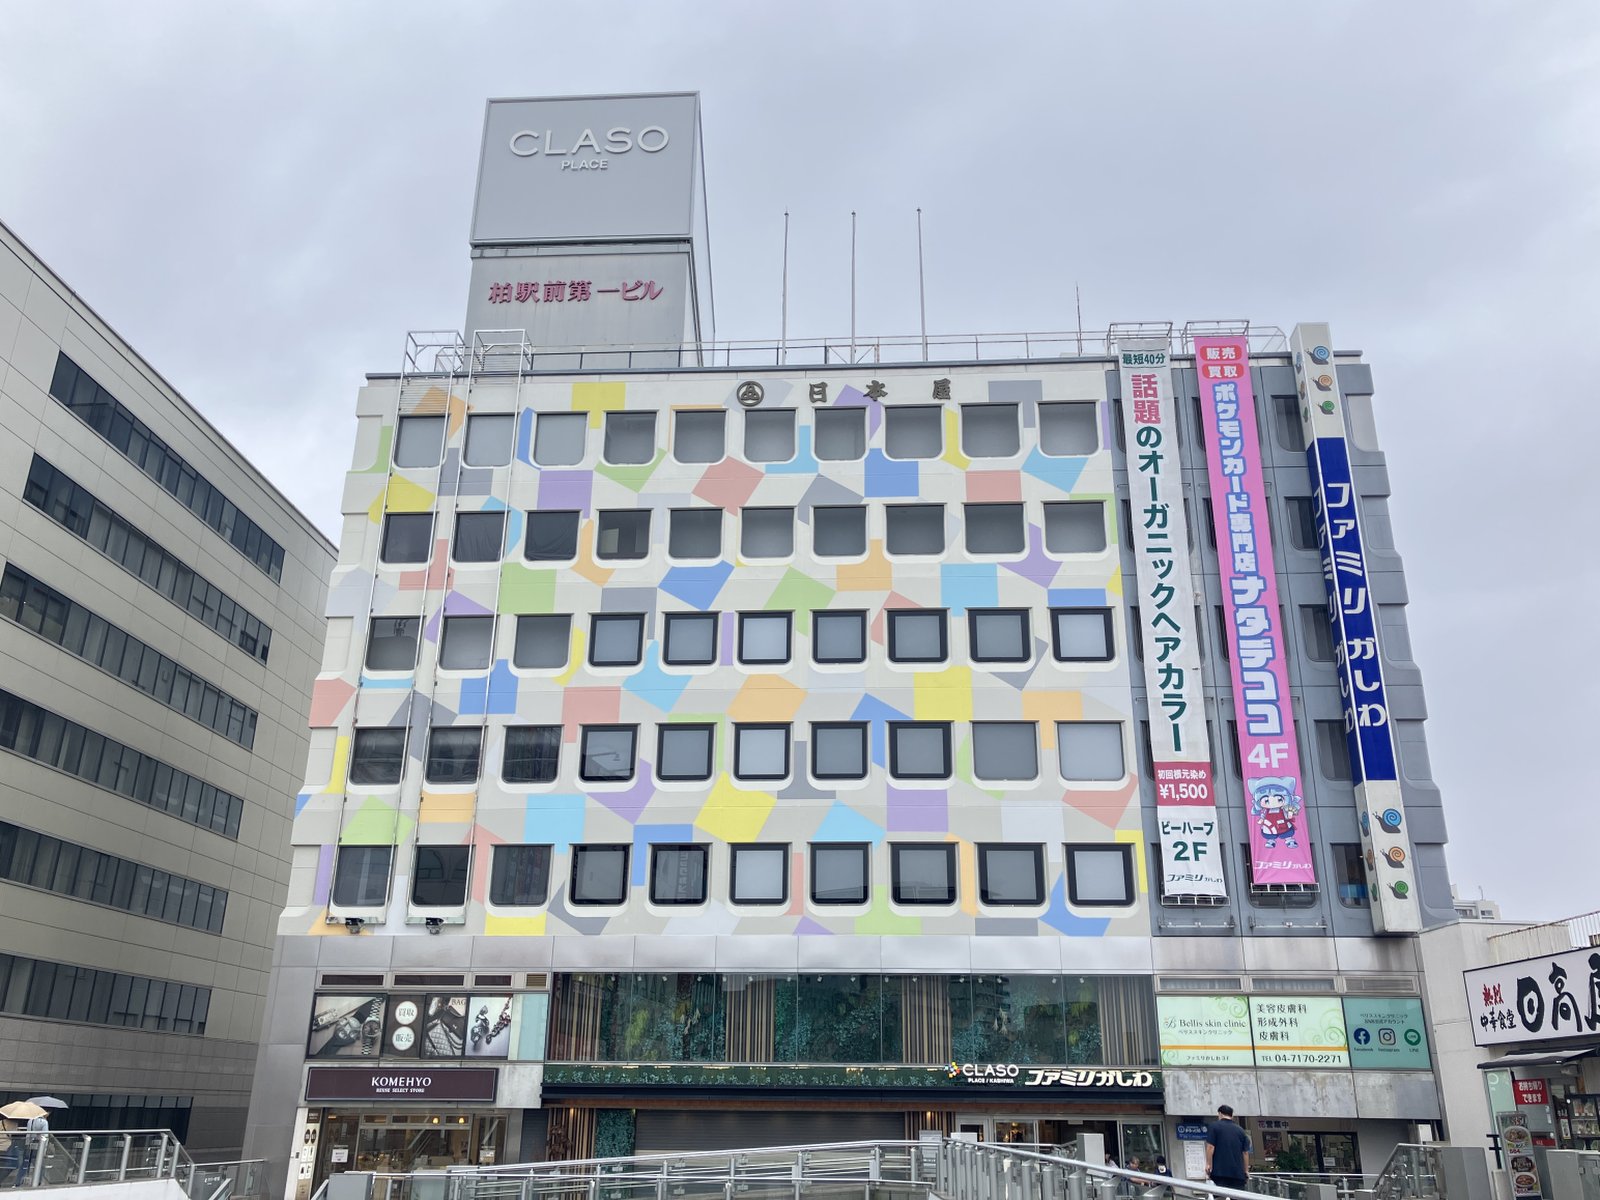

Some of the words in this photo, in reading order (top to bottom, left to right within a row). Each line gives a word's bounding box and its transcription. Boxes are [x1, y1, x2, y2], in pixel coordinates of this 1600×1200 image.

[508, 125, 670, 157] CLASO
[561, 158, 609, 170] PLACE
[488, 279, 664, 304] 柏駅前第一ビル
[1122, 352, 1166, 365] 最短40分
[1206, 347, 1236, 359] 販売
[1208, 365, 1238, 378] 買取
[1131, 373, 1188, 752] 話題のオーガニックヘアカラー
[1247, 743, 1289, 769] 4F
[1157, 769, 1207, 780] 初回根元染め
[1159, 783, 1208, 801] ¥1,500
[1172, 841, 1208, 862] 2F
[1257, 1003, 1307, 1014] 美容皮膚科
[1179, 1019, 1203, 1027] Bellis
[1205, 1019, 1222, 1027] skin
[1223, 1019, 1246, 1027] clinic
[1257, 1017, 1298, 1027] 形成外科
[1480, 1007, 1516, 1032] 中華食堂
[1259, 1031, 1289, 1041] 皮膚科
[1274, 1054, 1342, 1063] 04-7170-2271
[962, 1063, 1020, 1077] CLASO
[371, 1076, 432, 1087] KOMEHYO
